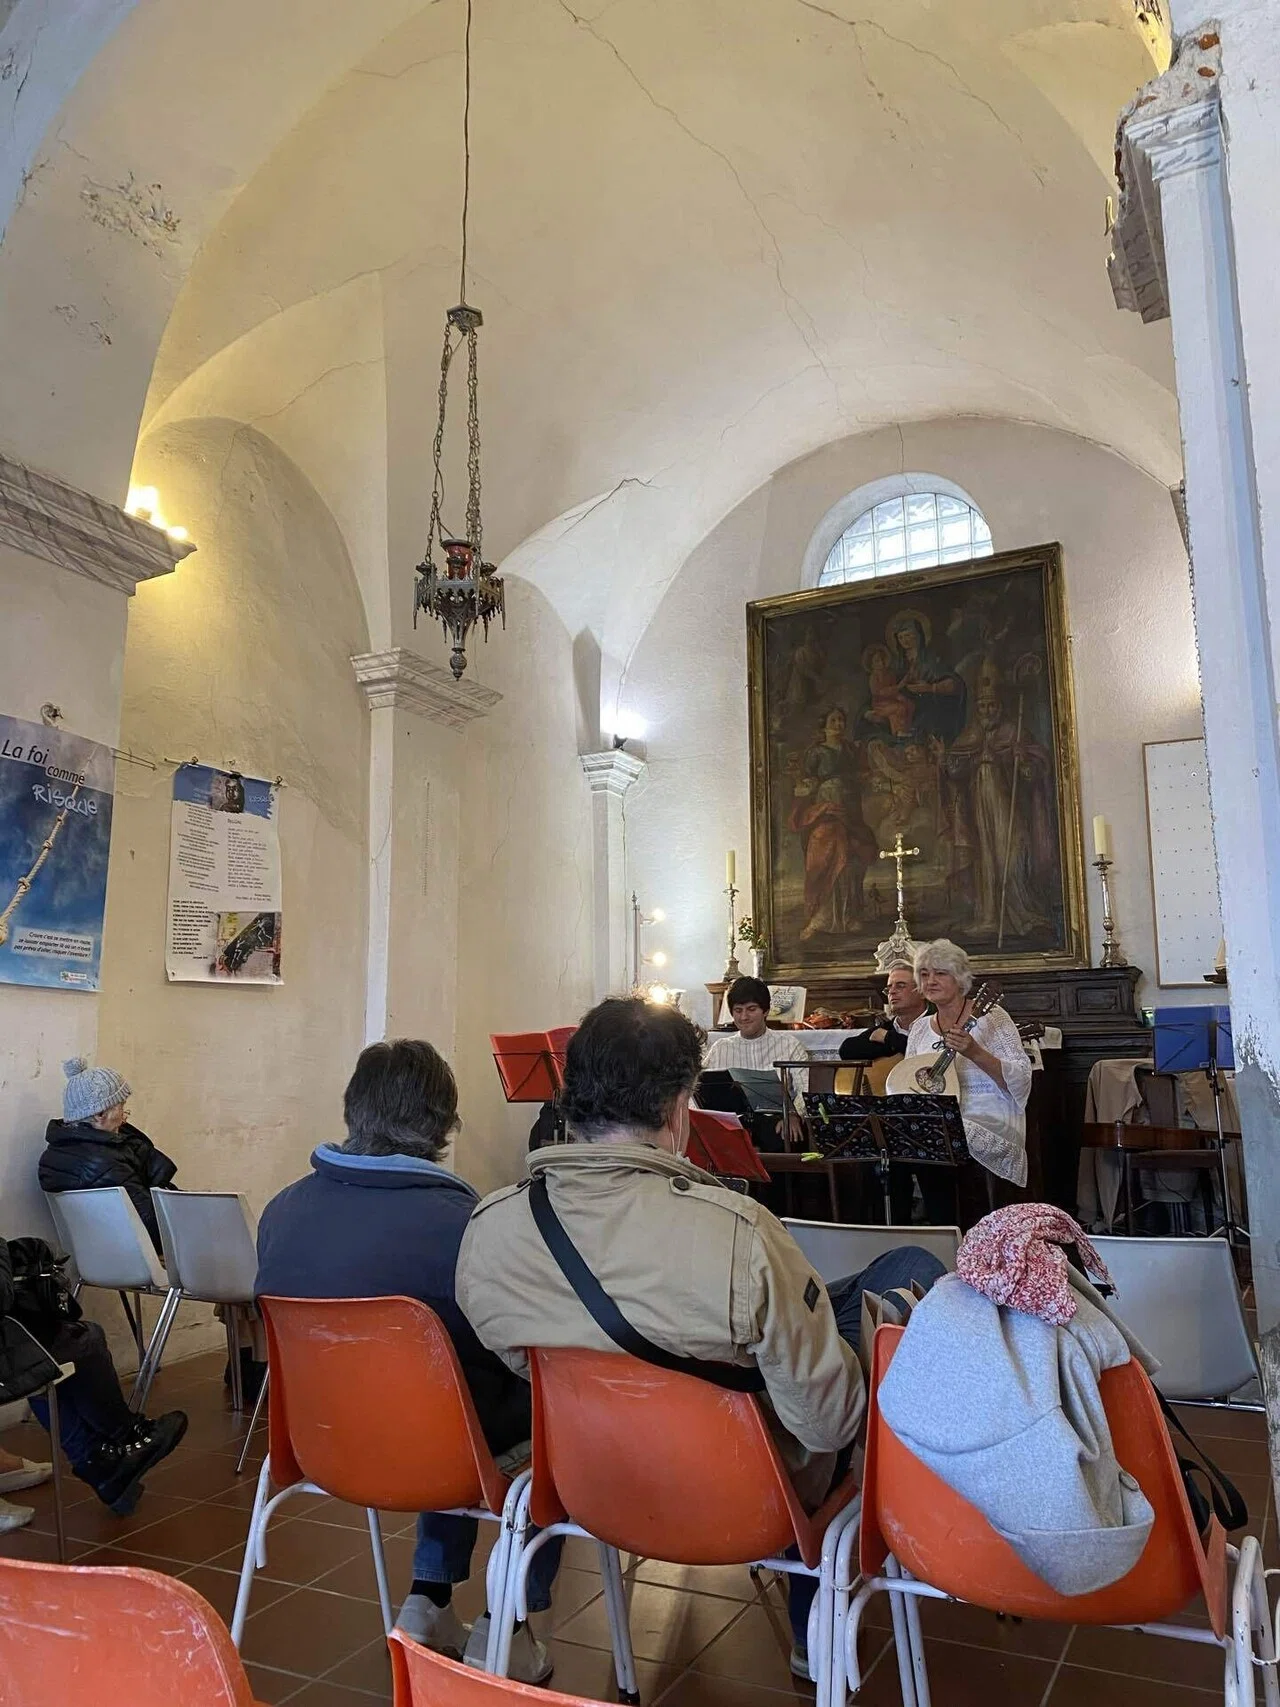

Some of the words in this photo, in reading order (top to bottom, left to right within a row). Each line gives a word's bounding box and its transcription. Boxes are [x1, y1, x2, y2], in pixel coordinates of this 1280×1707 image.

[2, 739, 23, 758] La
[28, 745, 50, 764] foi
[47, 766, 85, 784] comme
